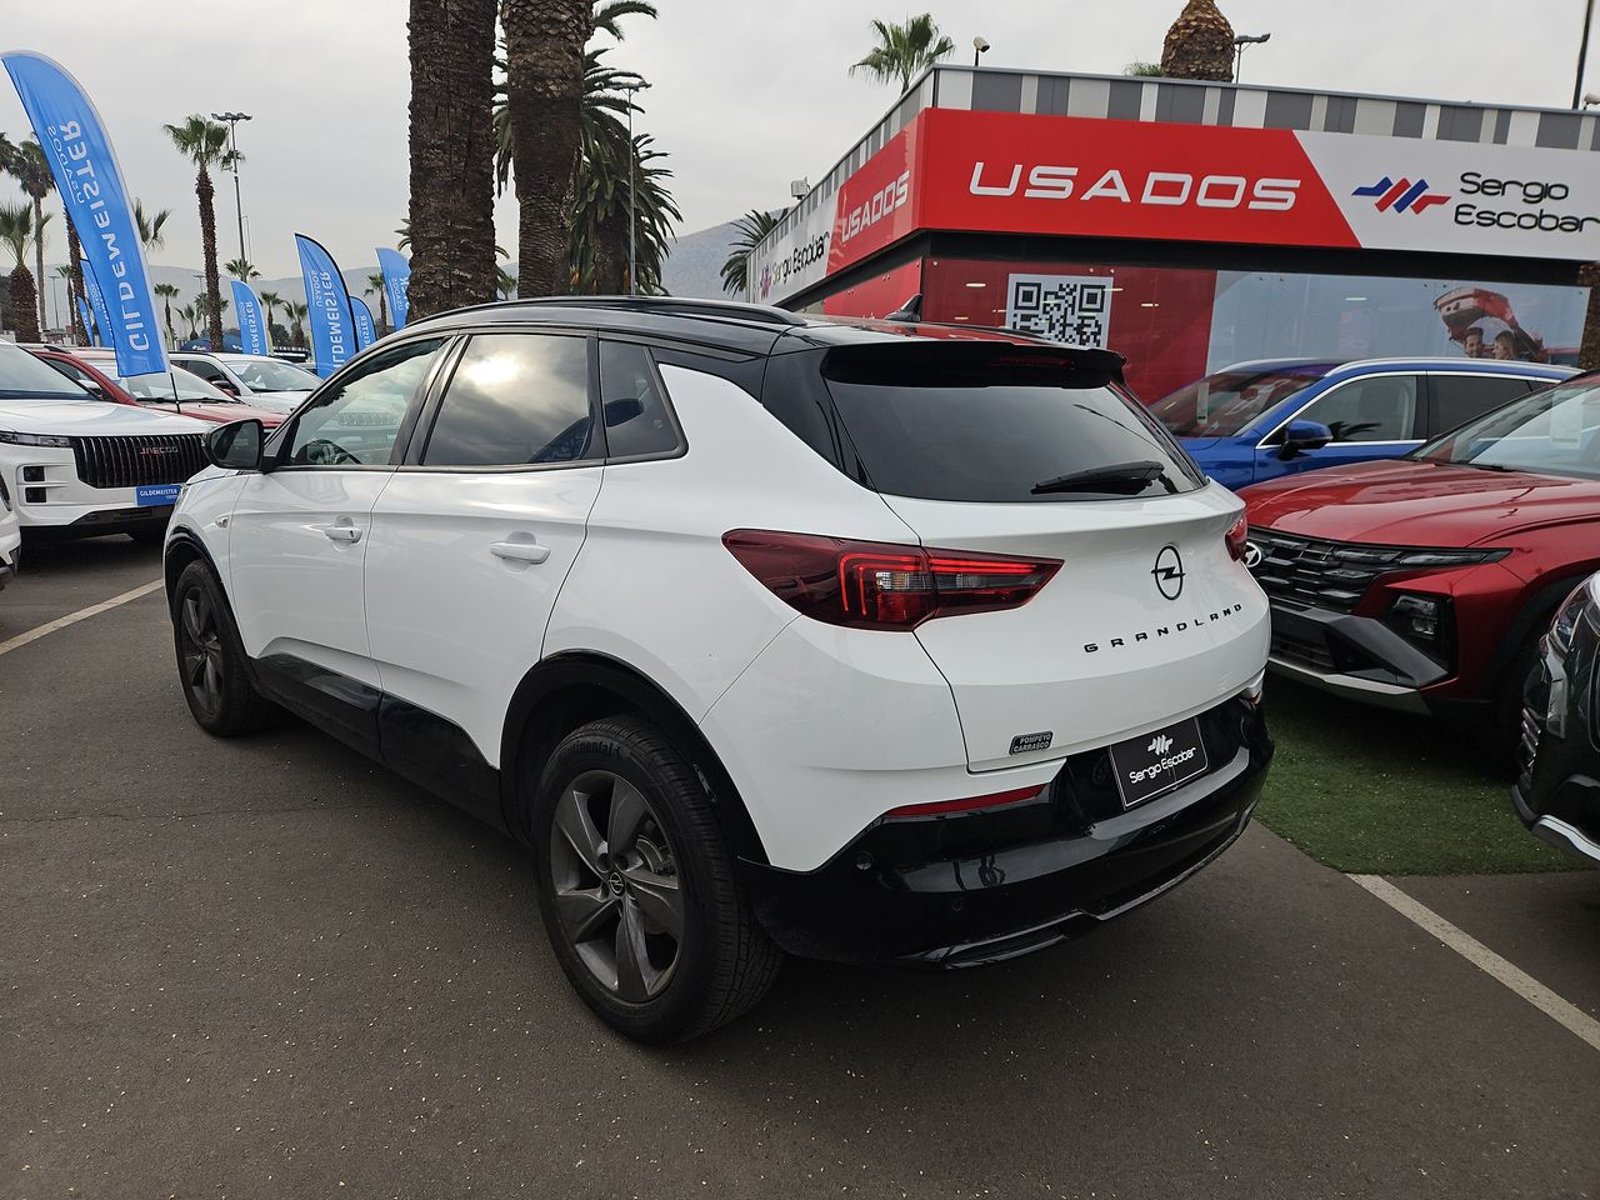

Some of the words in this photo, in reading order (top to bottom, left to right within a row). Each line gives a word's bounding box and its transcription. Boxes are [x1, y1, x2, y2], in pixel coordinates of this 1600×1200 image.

[969, 161, 1301, 212] USADOS
[1460, 171, 1569, 204] Sergio
[842, 170, 910, 243] USADOS
[1454, 208, 1600, 232] Escobar
[1083, 603, 1243, 653] GRANDLAND
[1013, 740, 1050, 752] CARRASCO
[1129, 763, 1162, 784] Sergio
[1161, 747, 1197, 770] Escobar
